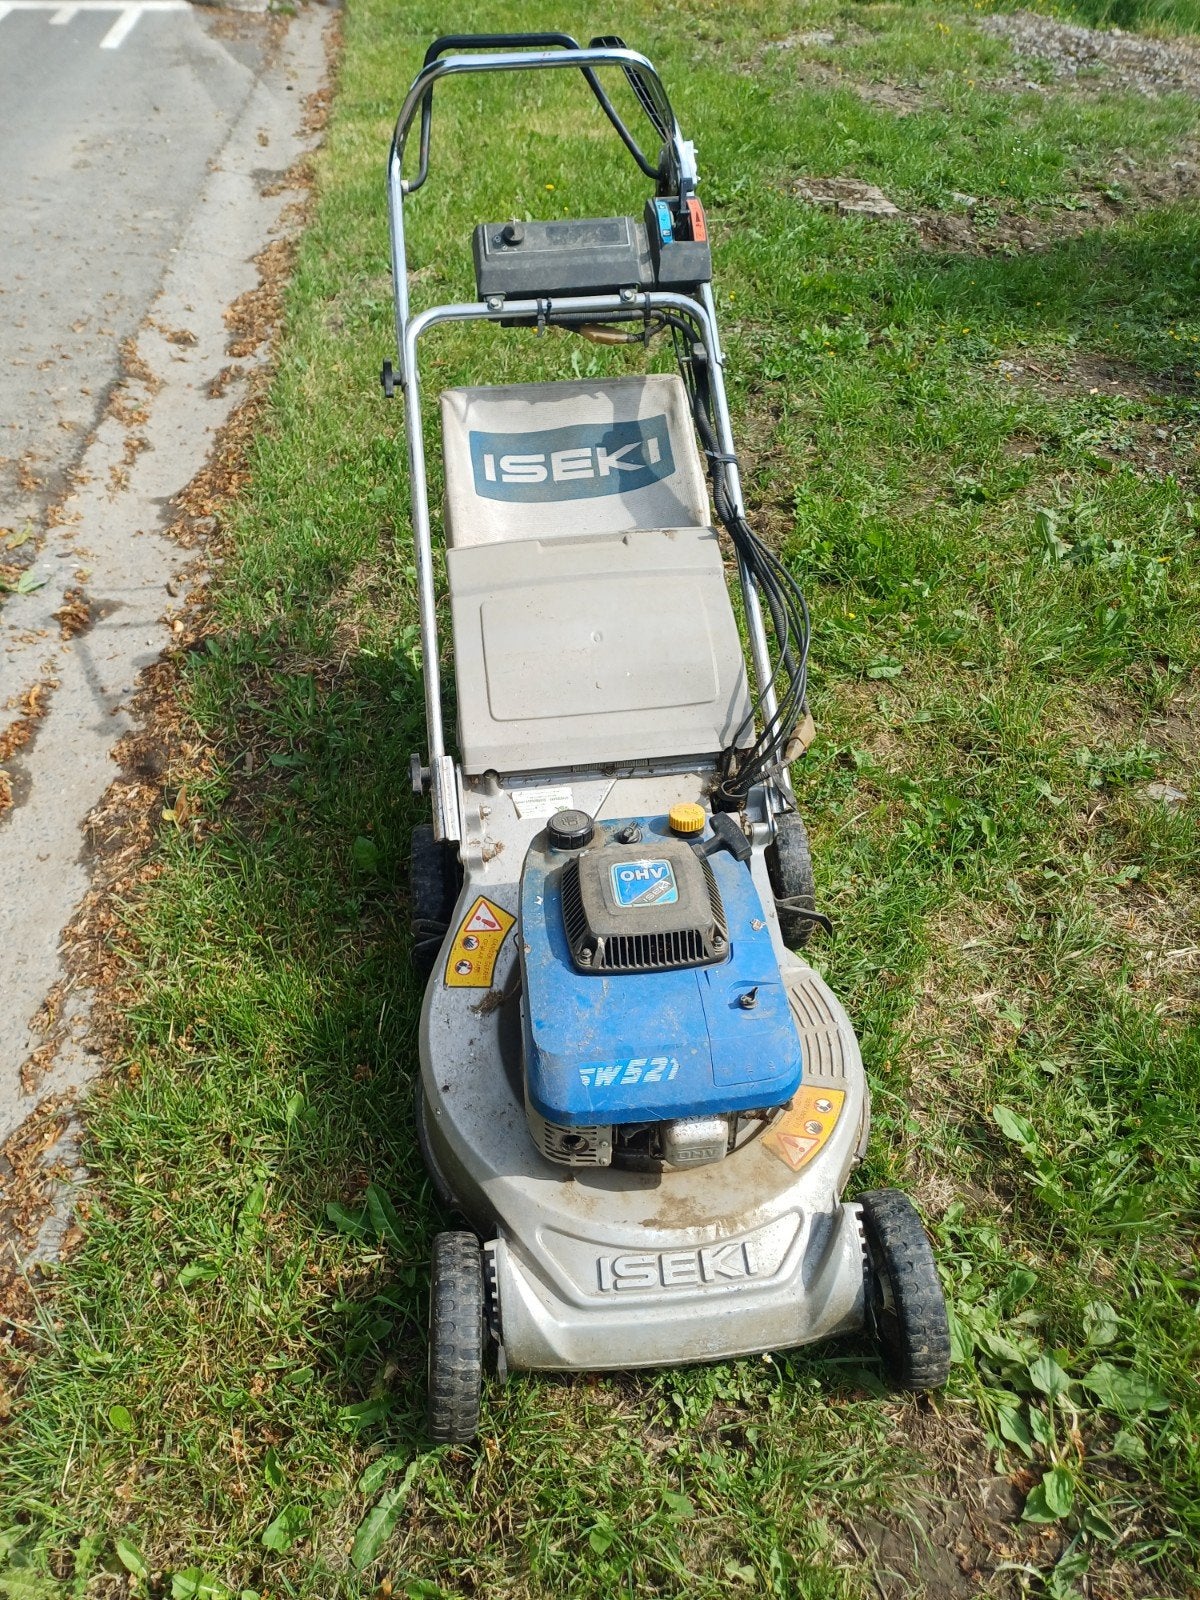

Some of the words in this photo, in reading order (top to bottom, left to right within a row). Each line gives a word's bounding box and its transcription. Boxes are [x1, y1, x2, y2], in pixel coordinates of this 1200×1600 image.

[484, 437, 661, 483] ISEKI
[620, 867, 665, 881] OHV
[597, 1242, 758, 1292] ISEKI
